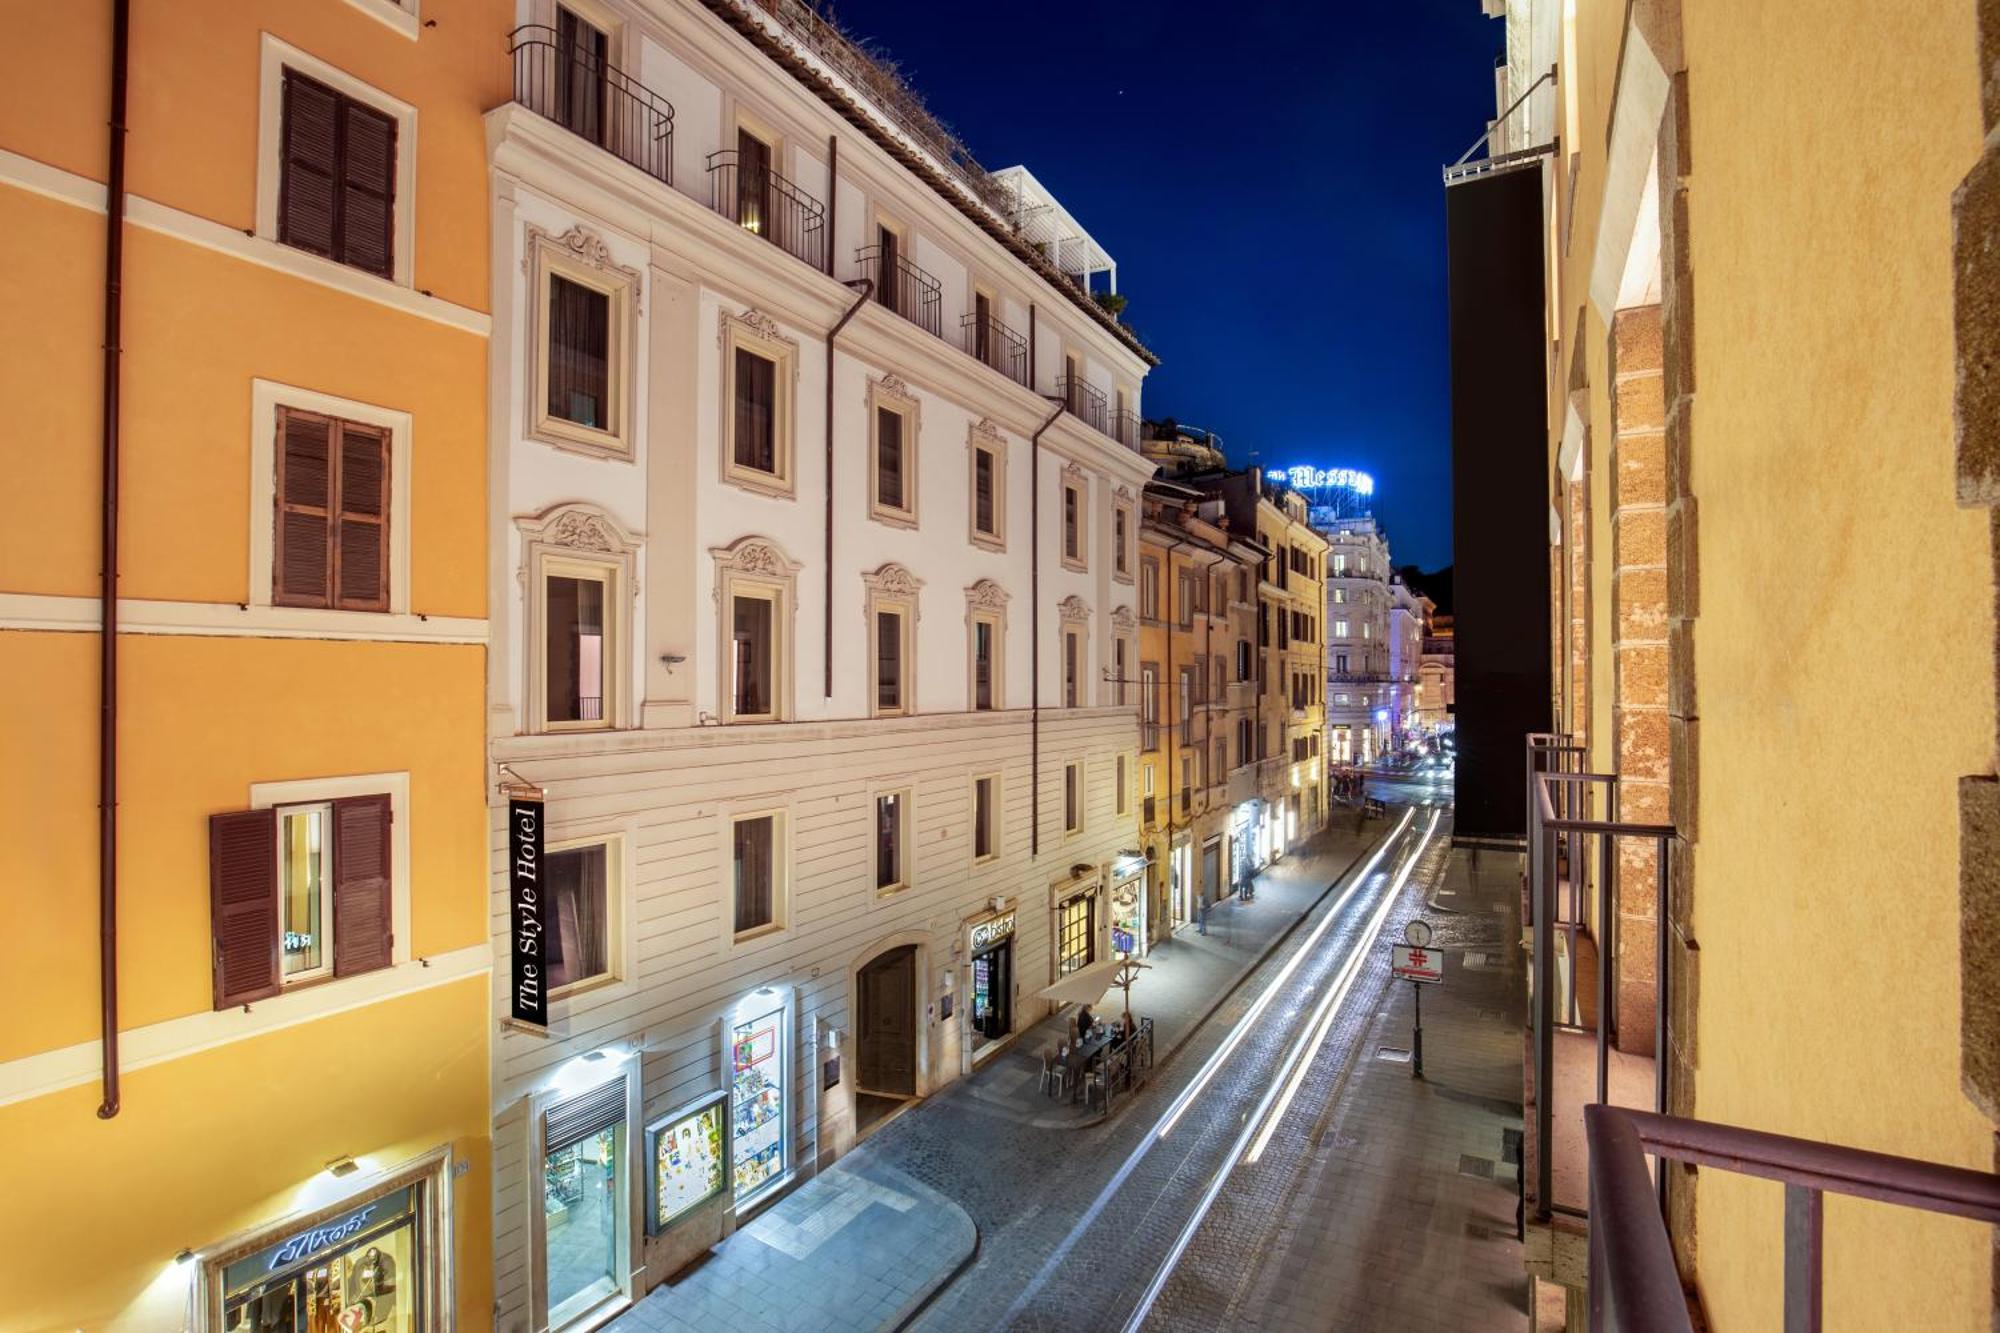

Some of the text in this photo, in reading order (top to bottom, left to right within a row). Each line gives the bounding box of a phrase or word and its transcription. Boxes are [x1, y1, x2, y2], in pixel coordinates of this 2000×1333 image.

[515, 808, 542, 1011] The Style Hotel
